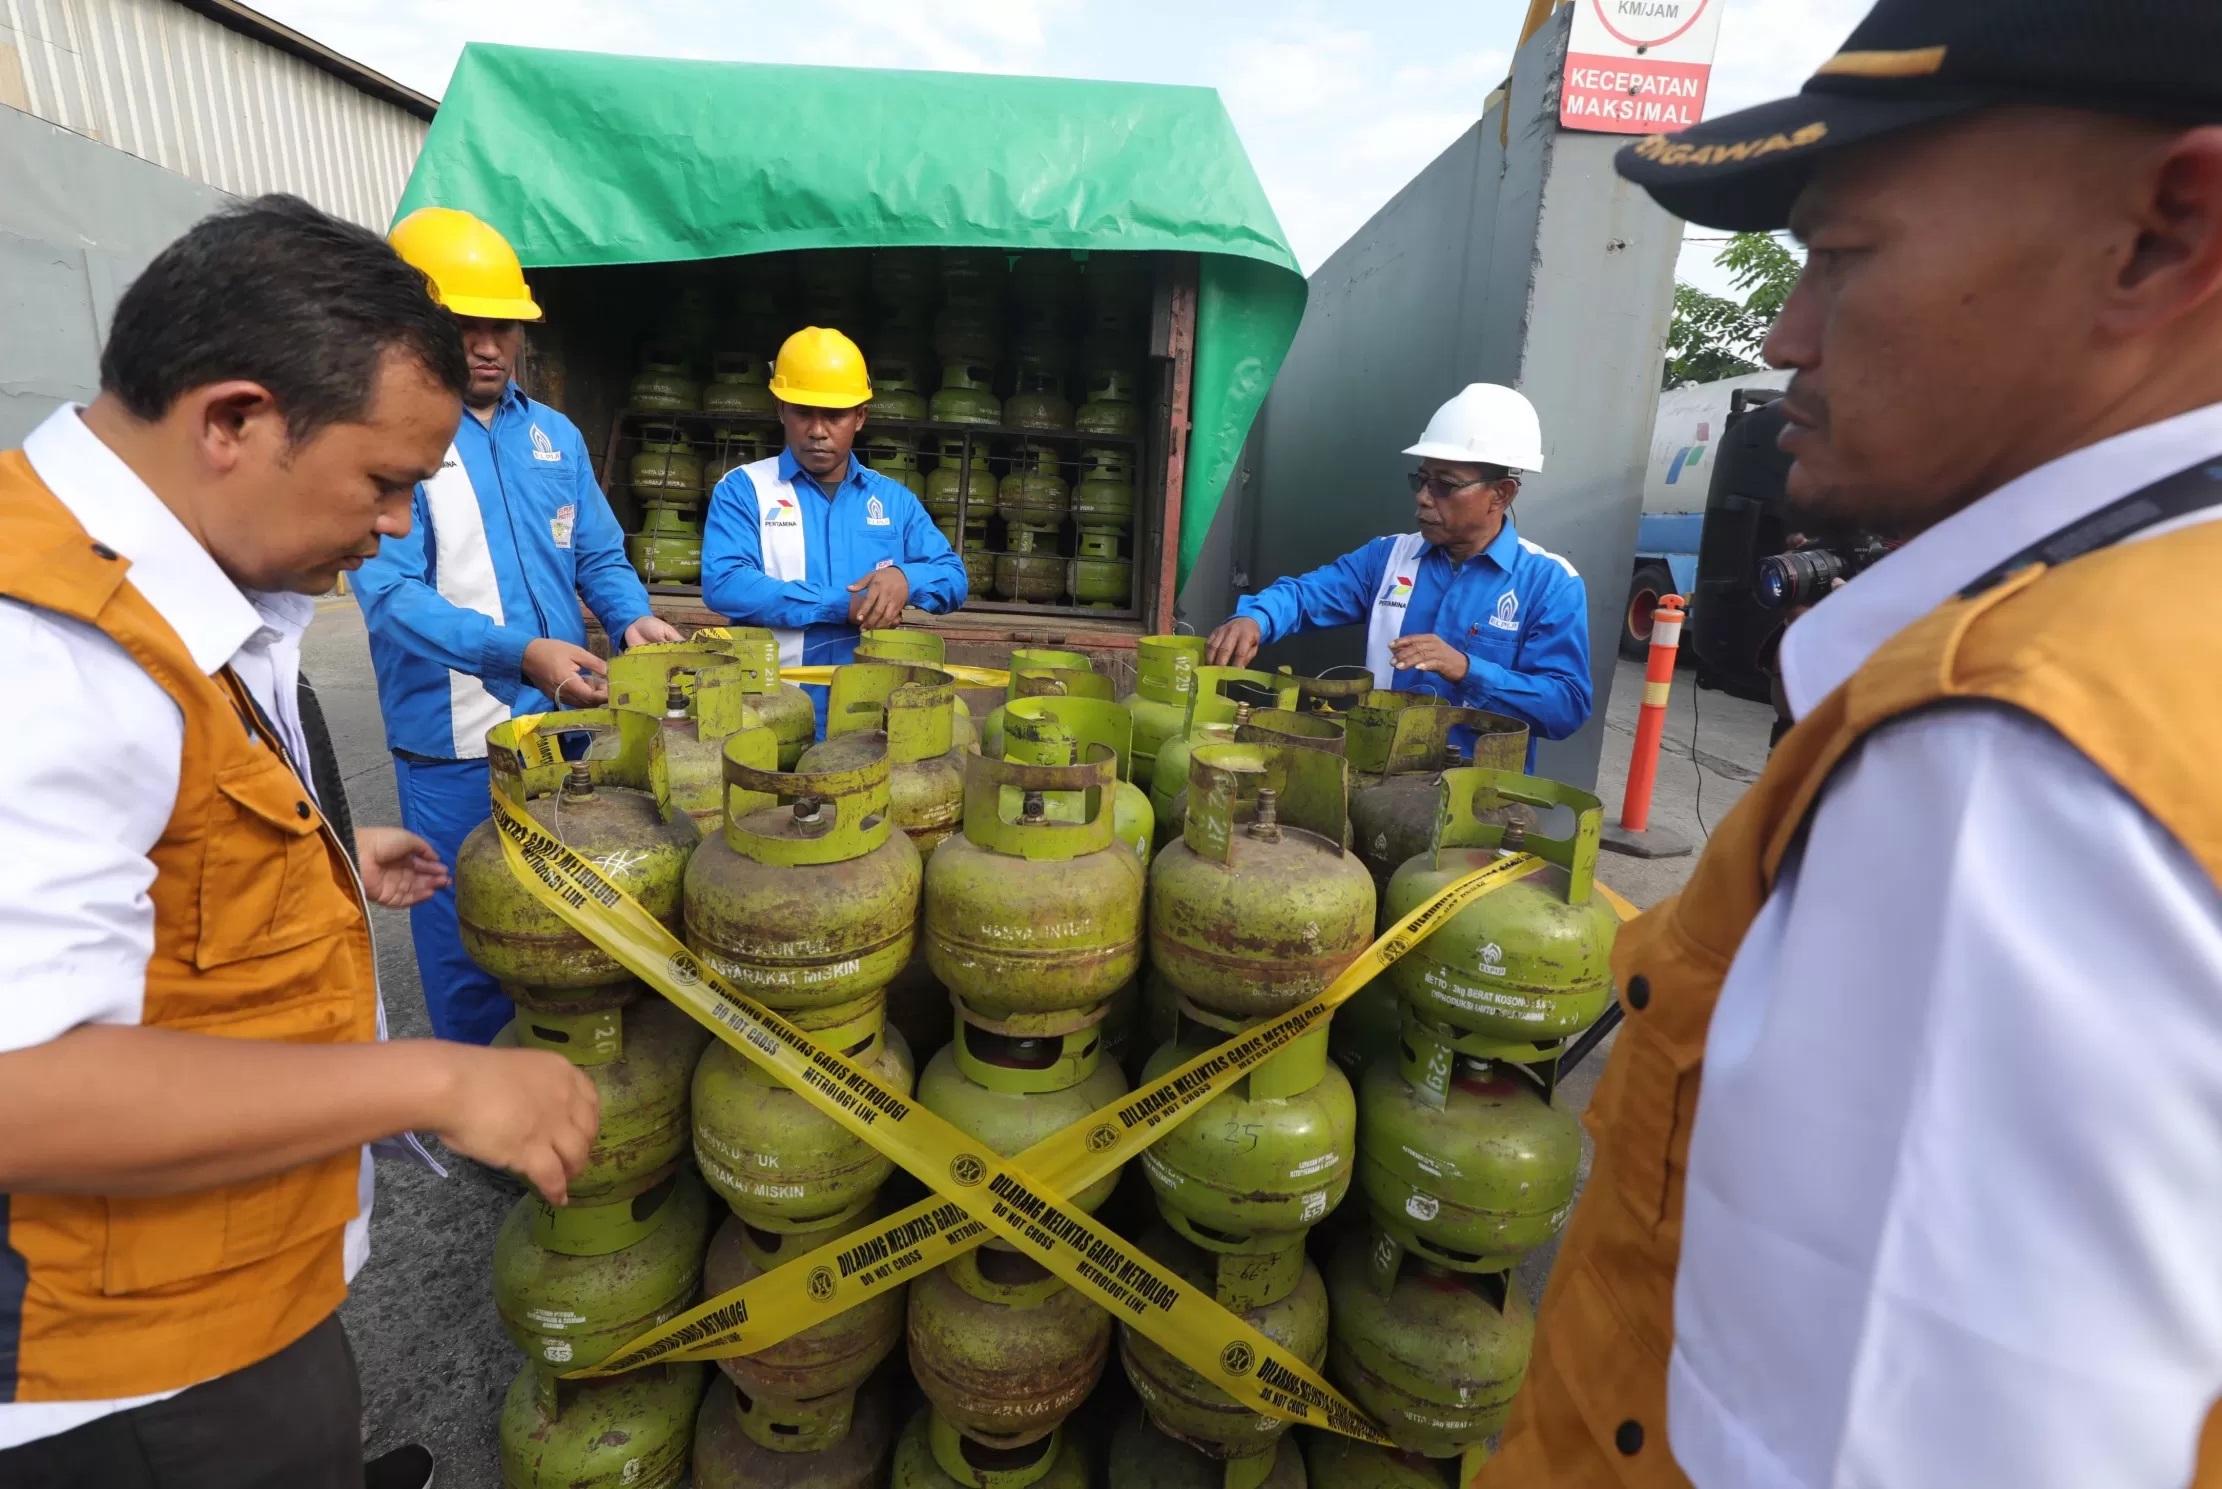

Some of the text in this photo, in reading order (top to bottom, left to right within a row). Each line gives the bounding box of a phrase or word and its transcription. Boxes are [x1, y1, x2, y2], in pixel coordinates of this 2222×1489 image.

[1617, 0, 1679, 19] KM/JAM
[1570, 67, 1698, 98] KECEPATAN
[1566, 94, 1693, 125] MAKSIMAL
[764, 520, 797, 528] PERTAMINA
[1490, 617, 1518, 630] ELPIJI
[560, 885, 588, 910] LINE
[804, 958, 861, 985] MISKIN
[1424, 971, 1447, 990] NETTO
[1453, 984, 1466, 998] 3kg
[1466, 987, 1495, 1002] BERAT
[1430, 988, 1474, 1010] DIPRODUKSI
[711, 1002, 780, 1057] DO NOT CROSS
[761, 1016, 817, 1058] MELINTAS
[812, 1050, 850, 1082] GARIS
[847, 1068, 911, 1123] METROLOGI
[1118, 1003, 1326, 1129] DILARANG MELINTAS GARIS METROLOGI
[1146, 1115, 1161, 1128] DO
[1162, 1104, 1180, 1118] NOT
[1183, 1082, 1212, 1106] CROSS
[1237, 1033, 1291, 1070] METROLOGY
[801, 1065, 879, 1126] METROLOGY LINE
[1224, 1121, 1264, 1157] 25
[755, 1184, 804, 1199] MISKIN
[988, 1172, 1180, 1313] DILARANG MELINTAS GARIS METROLOGI
[991, 1201, 1056, 1251] DO NOT CROSS
[836, 1235, 890, 1278] DILARANG
[884, 1213, 937, 1255] MELINTAS
[860, 1271, 875, 1287] DO
[873, 1263, 894, 1280] NOT
[892, 1249, 923, 1271] CROSS
[1075, 1260, 1148, 1315] METROLOGY LINE
[696, 1298, 749, 1339] METROLOGI
[1259, 1387, 1309, 1418] DO NOT CROSS
